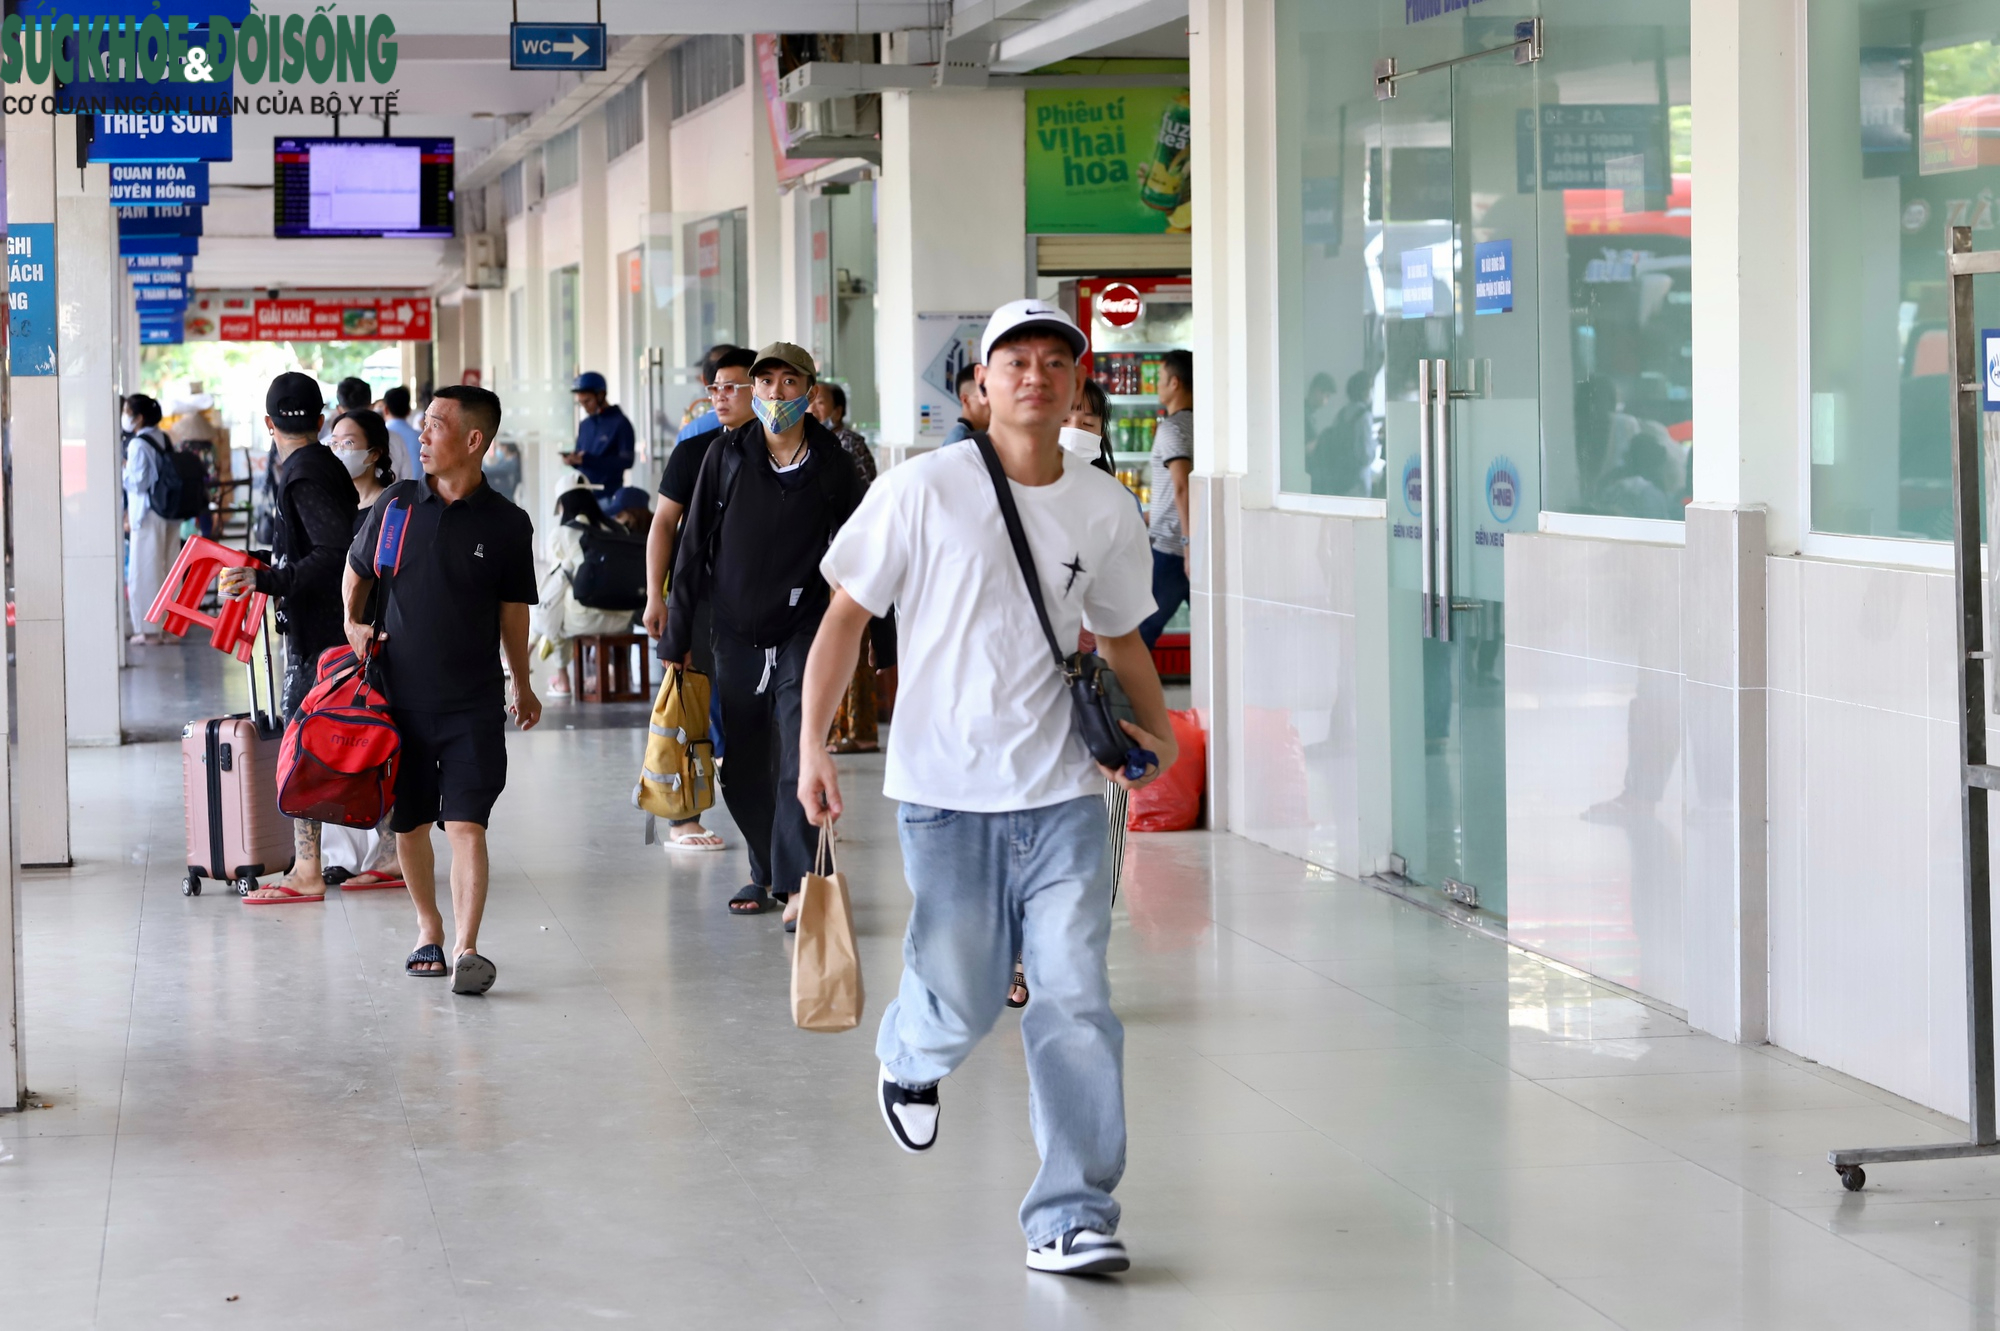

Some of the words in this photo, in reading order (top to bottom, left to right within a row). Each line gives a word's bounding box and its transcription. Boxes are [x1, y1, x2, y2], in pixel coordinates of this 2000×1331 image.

[522, 40, 551, 54] WC
[1037, 100, 1103, 127] Phiêu
[1106, 96, 1125, 120] tí
[1072, 125, 1126, 158] hài
[113, 166, 152, 181] QUAN
[156, 163, 186, 180] HÓA
[1063, 155, 1129, 187] hòa
[1408, 484, 1422, 501] HN
[1492, 488, 1513, 507] HNB
[384, 525, 395, 549] mitre
[331, 734, 369, 747] mitre
